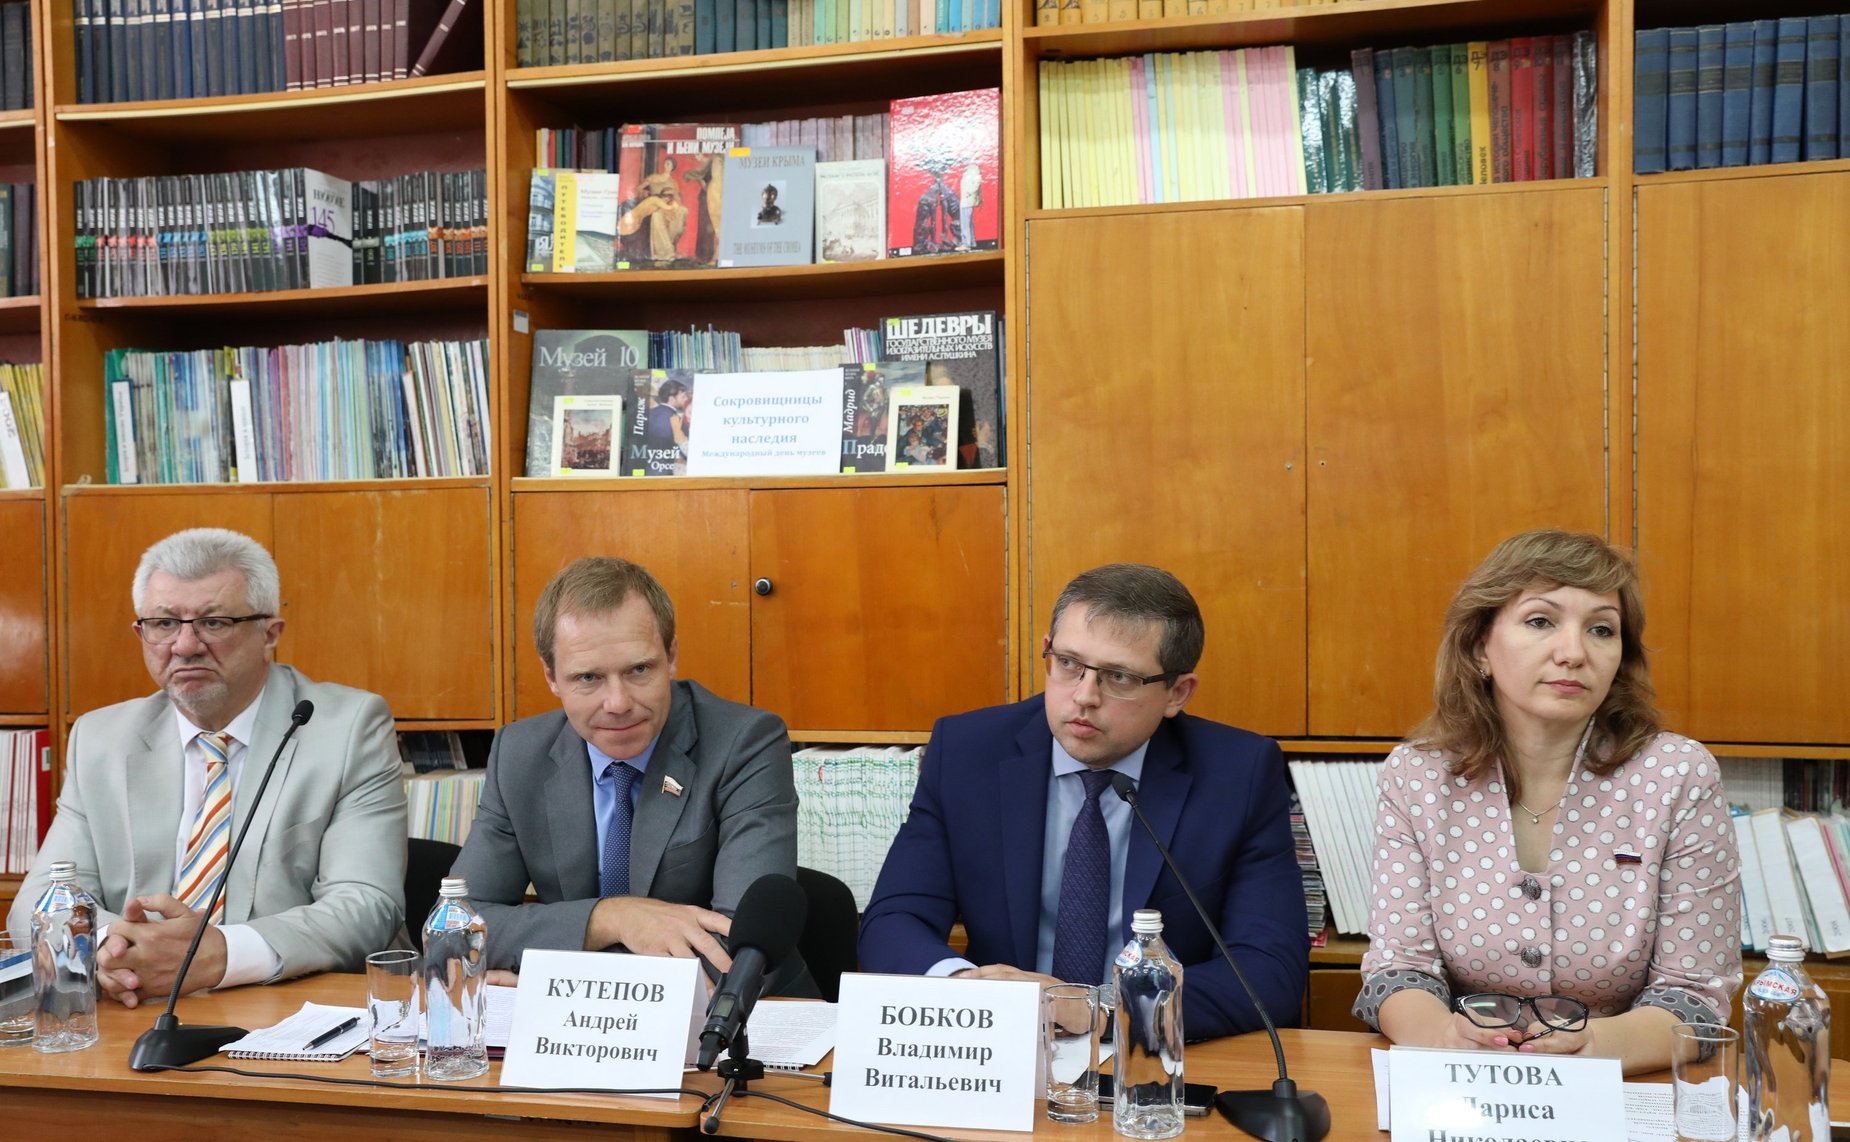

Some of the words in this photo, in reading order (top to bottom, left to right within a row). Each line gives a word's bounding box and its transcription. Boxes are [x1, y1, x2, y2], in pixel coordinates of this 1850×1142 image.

[738, 156, 770, 169] МУЗЕИ
[771, 154, 806, 168] КРЫМА
[312, 206, 335, 233] 145
[886, 314, 992, 340] ШЕДЕВРЫ
[886, 335, 966, 348] ГОСУДАРСТВЕННОГО
[966, 334, 993, 344] МУЗЕЯ
[886, 343, 955, 355] ИЗОБРАЗИТЕЛЬНЫХ
[955, 342, 993, 351] ИСКУССТВ
[539, 346, 608, 371] Музей
[620, 345, 640, 368] 10
[901, 352, 928, 361] ИМЕНИ
[713, 396, 823, 409] Сокровищницы
[843, 389, 859, 433] Мадрид
[633, 397, 648, 436] Париж
[723, 415, 810, 428] культурного
[731, 434, 798, 445] наследия
[630, 444, 681, 464] Музей
[701, 449, 773, 458] Международный
[796, 449, 827, 458] музеев
[546, 978, 665, 1003] КУТЕПОВ
[563, 1010, 638, 1034] Андрей
[880, 1005, 994, 1029] БОБКОВ
[534, 1036, 658, 1063] Викторович
[877, 1037, 993, 1066] Владимир
[864, 1067, 1002, 1093] Витальевич
[1444, 1063, 1563, 1086] ТУТОВА
